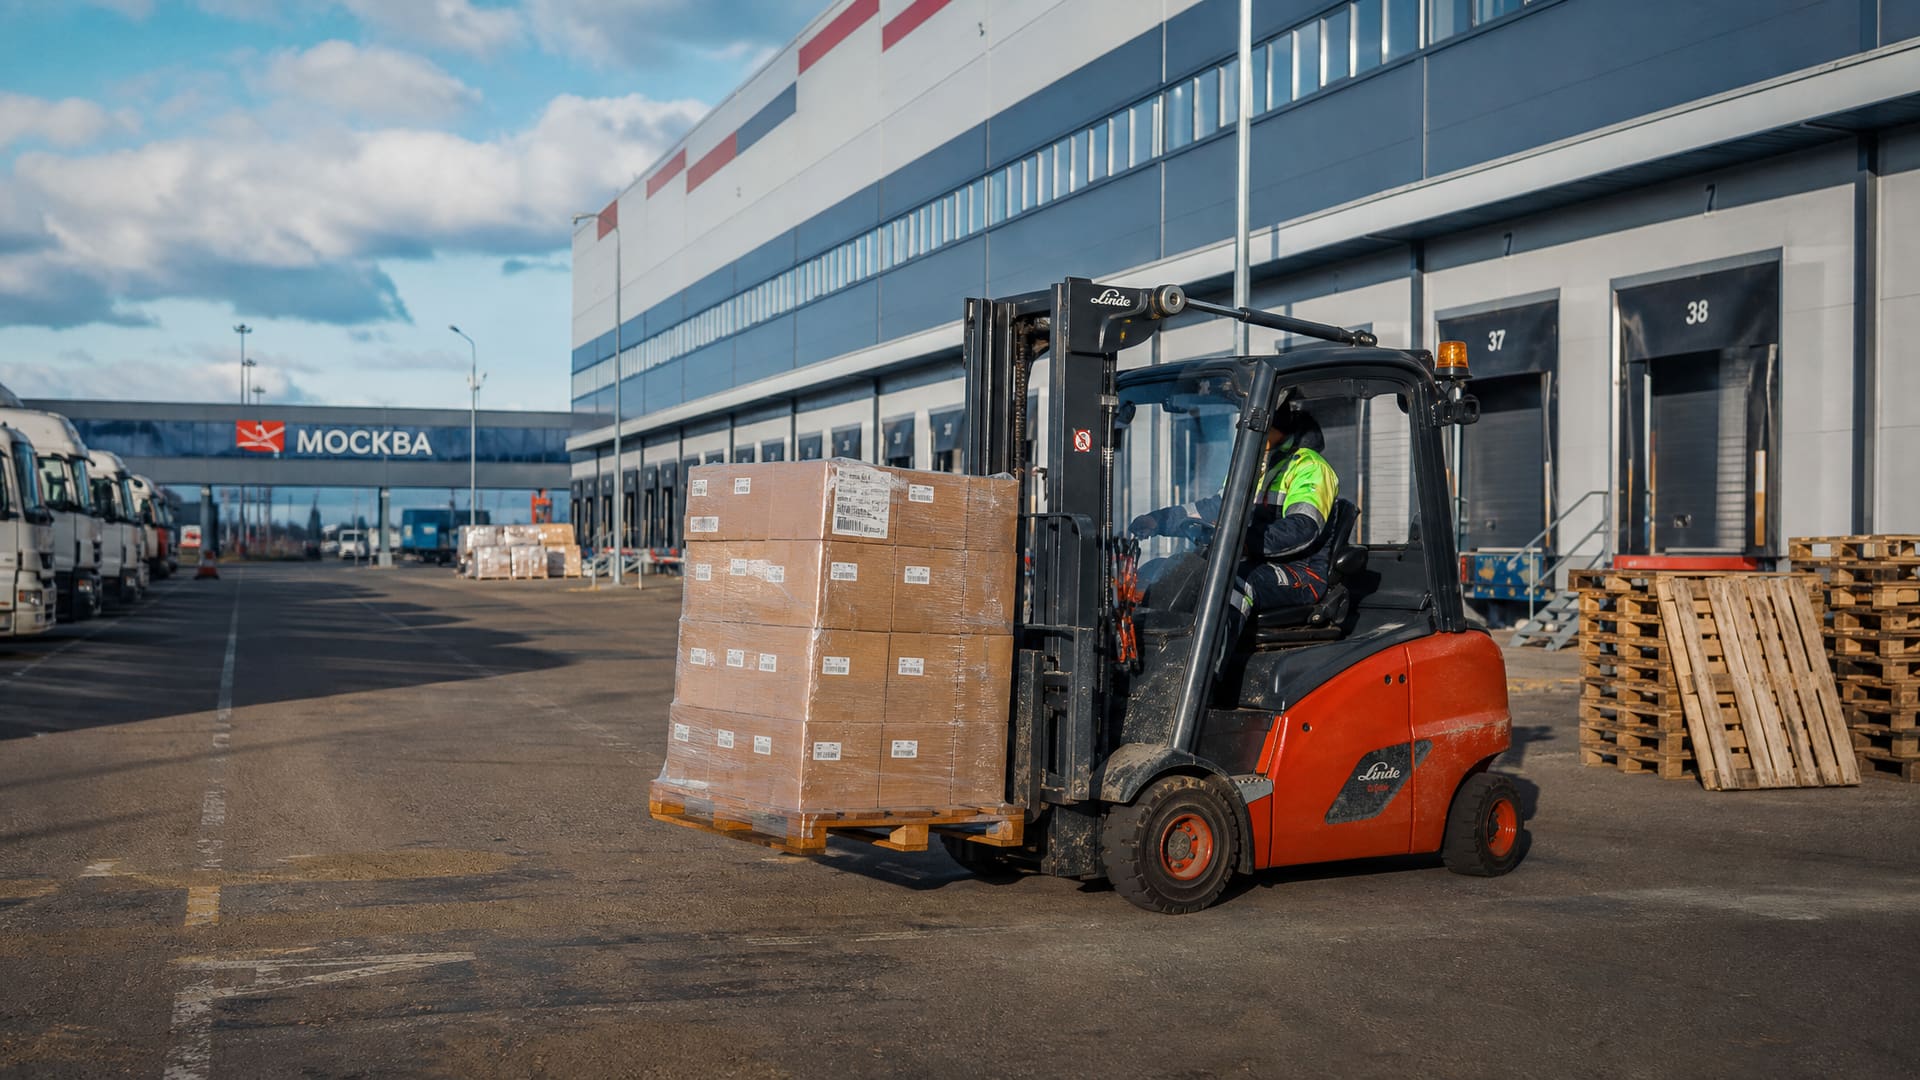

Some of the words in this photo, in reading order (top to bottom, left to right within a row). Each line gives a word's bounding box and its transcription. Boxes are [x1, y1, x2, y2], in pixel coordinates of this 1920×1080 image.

[1090, 288, 1131, 307] Linde
[1685, 299, 1709, 325] 38
[1487, 329, 1507, 352] 37
[296, 429, 433, 456] МОСКВА
[1357, 761, 1401, 782] Linde
